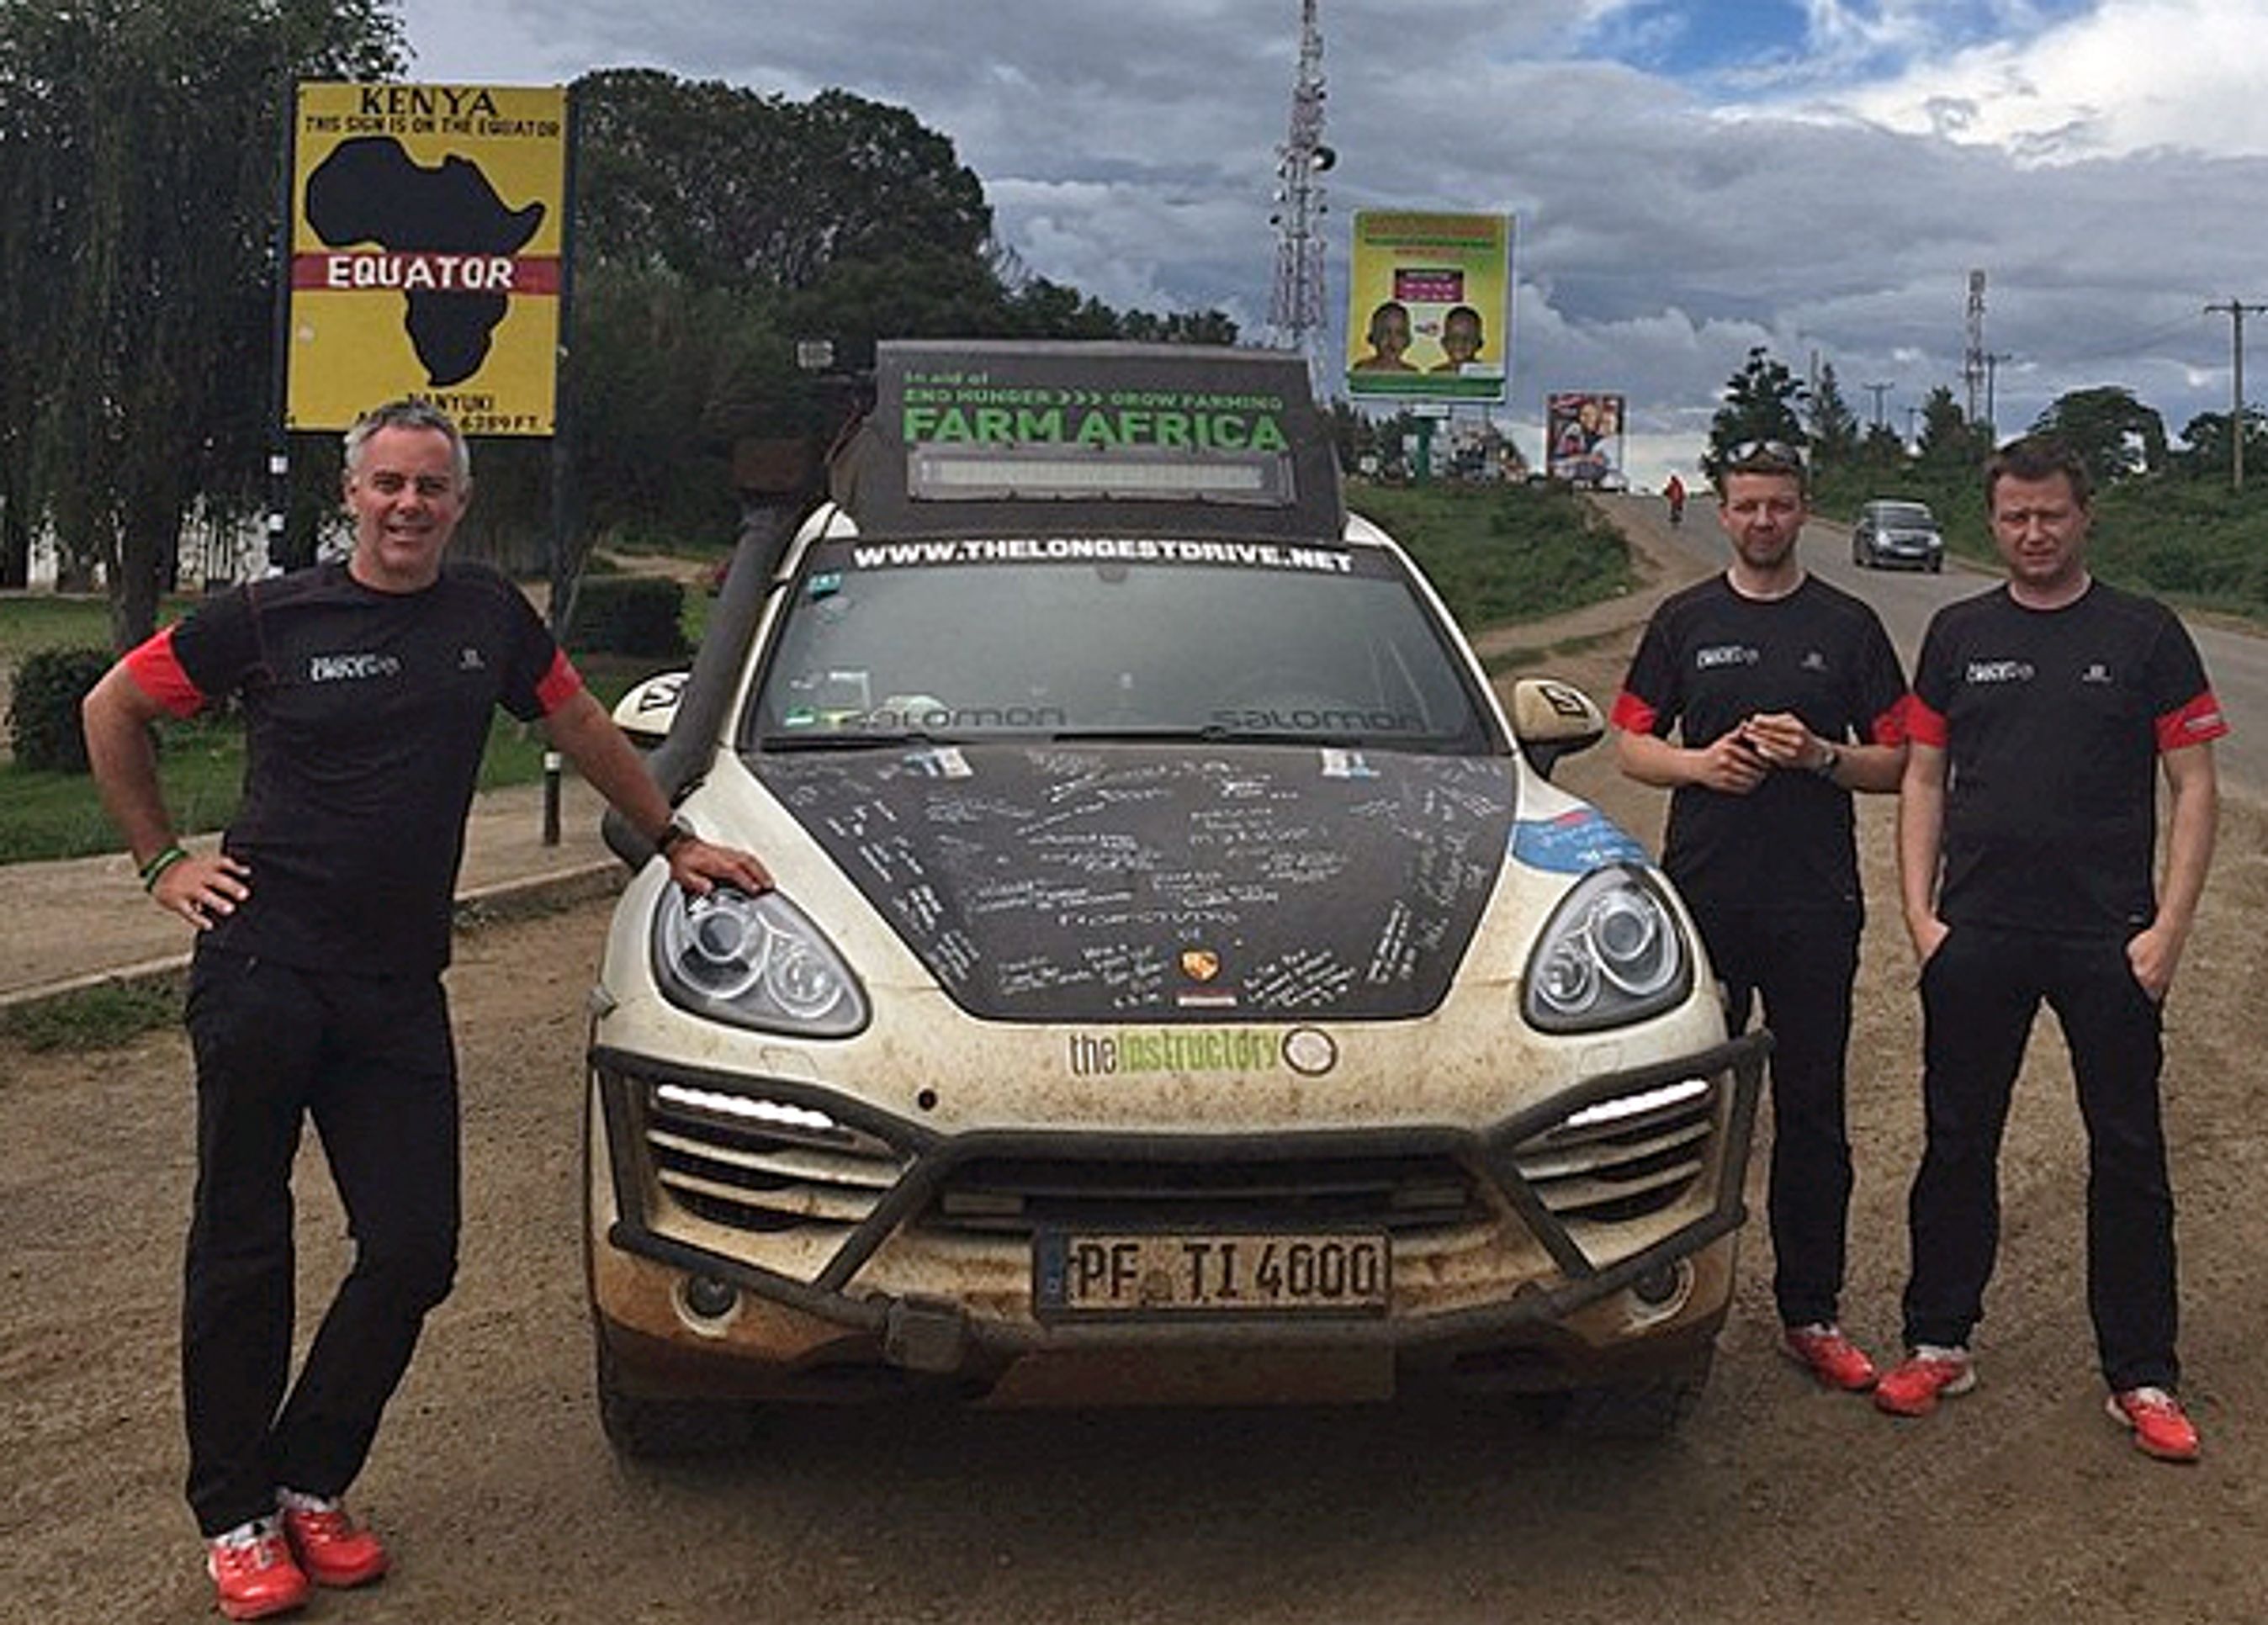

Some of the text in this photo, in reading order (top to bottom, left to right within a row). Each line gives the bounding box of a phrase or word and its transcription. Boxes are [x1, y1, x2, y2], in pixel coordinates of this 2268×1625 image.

[360, 87, 497, 115] KENYA
[306, 116, 560, 138] THIS SIGN IS ON THE EQUATOR
[328, 257, 513, 288] EQUATOR
[903, 389, 1284, 411] END HUNGER GROW FARMING
[903, 407, 1289, 452] FARM AFRICA
[854, 539, 1352, 573] WWW.THELONGESTDRIVE.NET
[1077, 1243, 1140, 1299] PF
[1256, 1243, 1377, 1299] 4000
